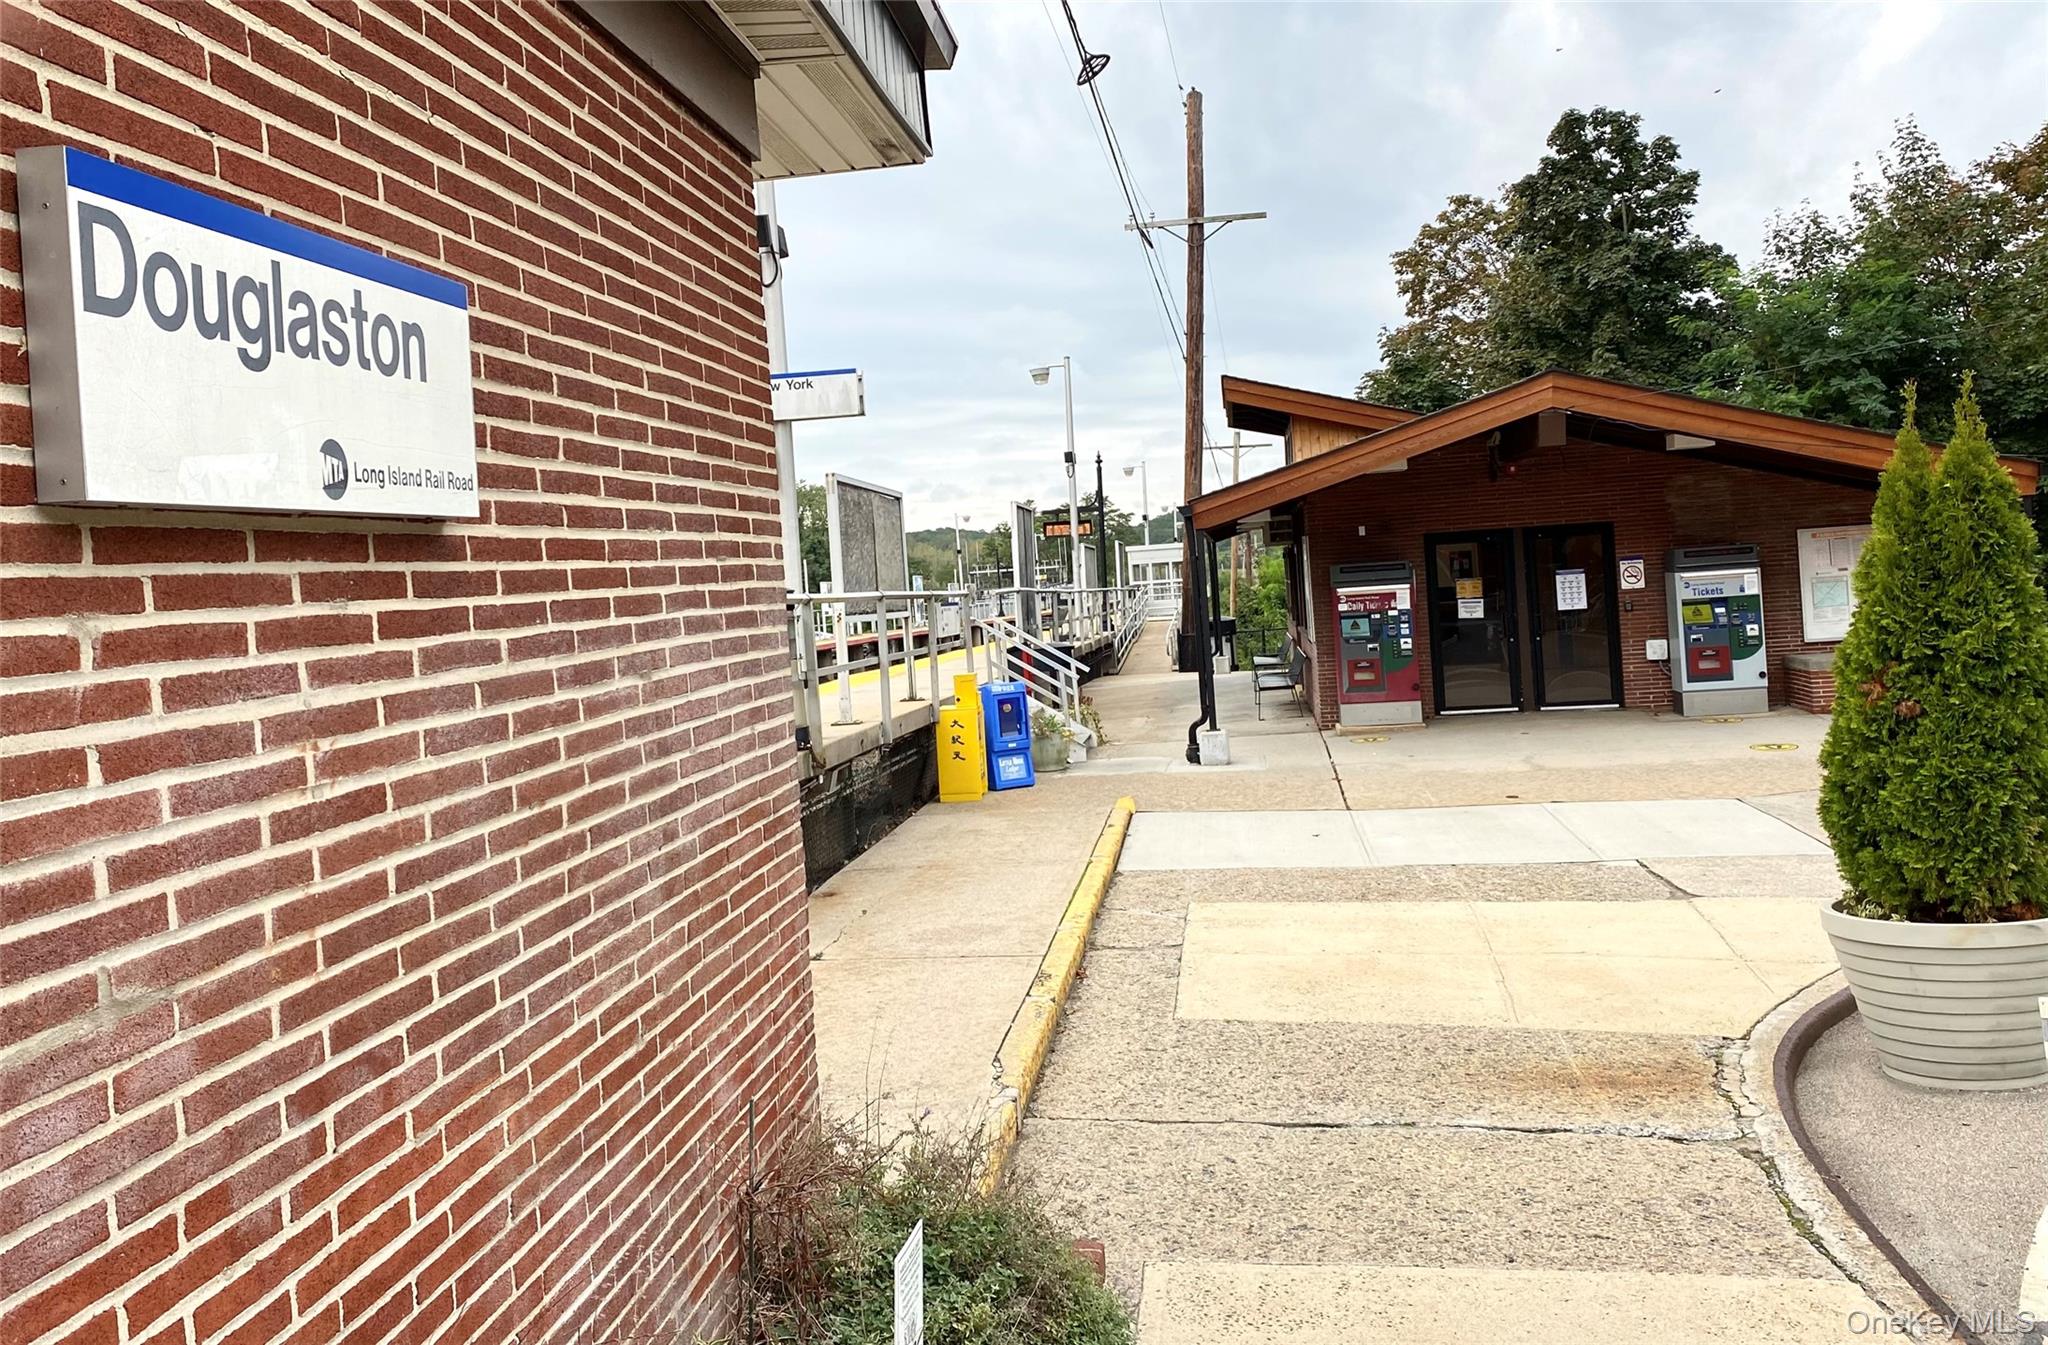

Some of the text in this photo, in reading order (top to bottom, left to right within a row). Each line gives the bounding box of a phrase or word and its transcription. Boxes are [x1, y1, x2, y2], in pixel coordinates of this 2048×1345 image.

[78, 201, 427, 382] Douglaston
[786, 378, 814, 390] York
[354, 461, 474, 491] Long Island Rail Road
[1691, 586, 1724, 597] Tickets
